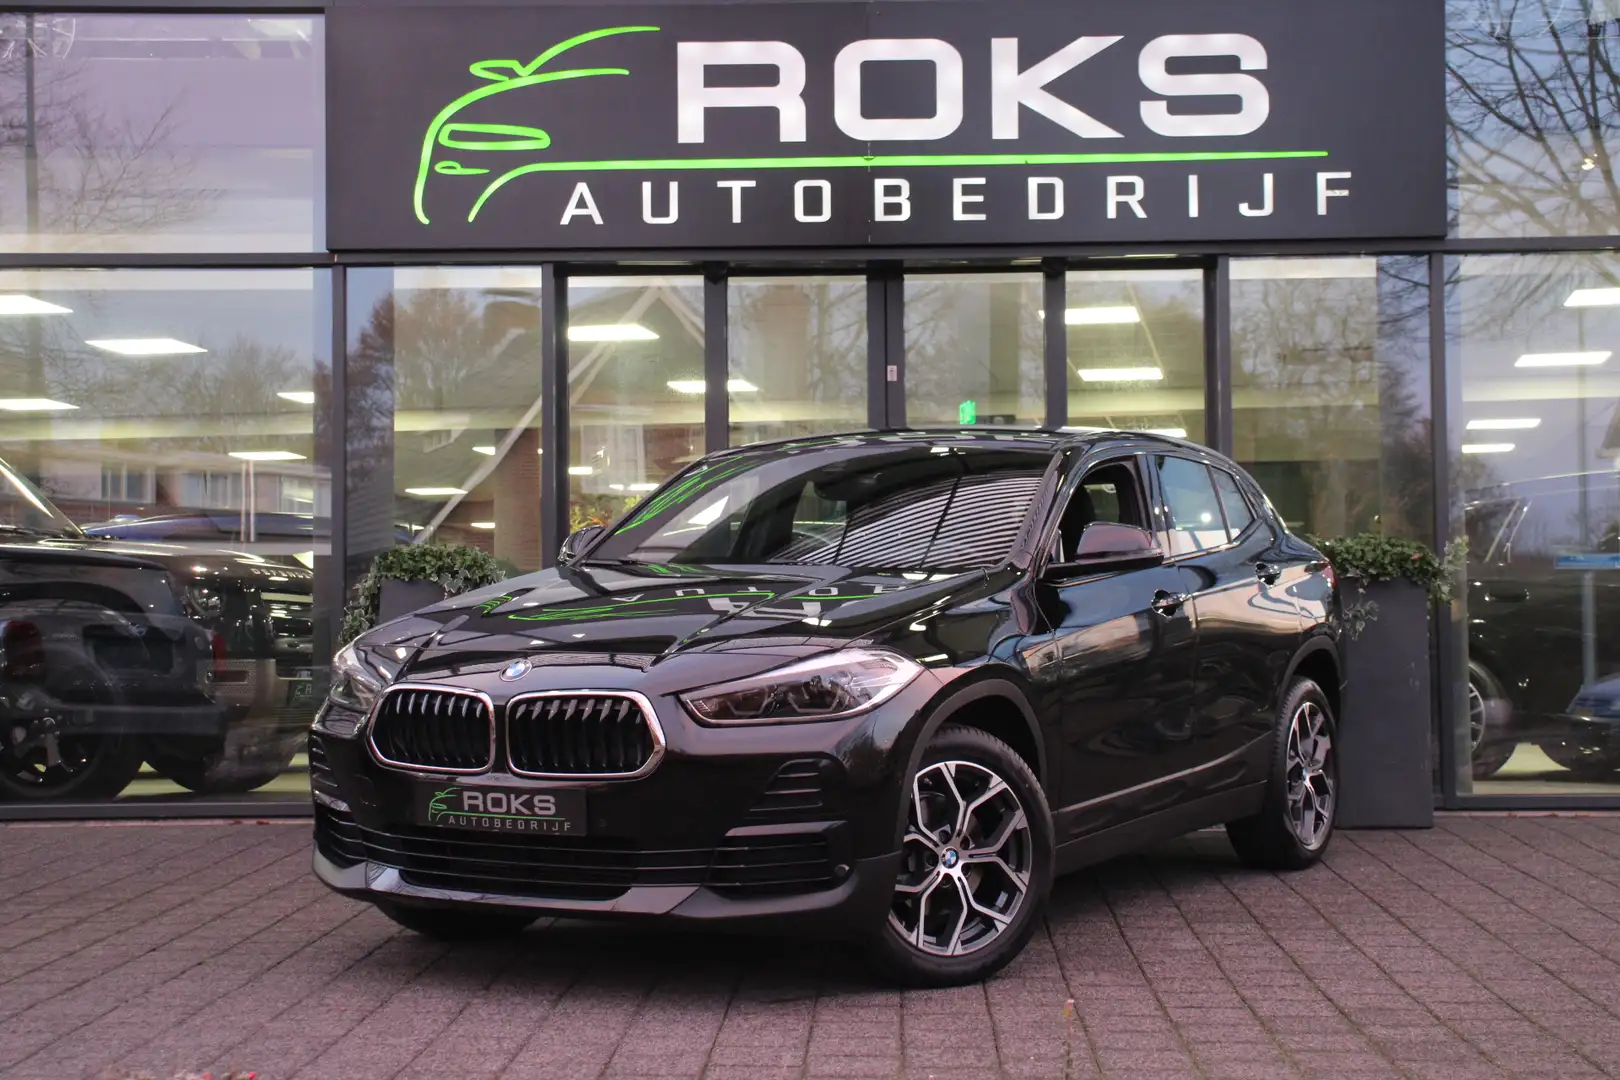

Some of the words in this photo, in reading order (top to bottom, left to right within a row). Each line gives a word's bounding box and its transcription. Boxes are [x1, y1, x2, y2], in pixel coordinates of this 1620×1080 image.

[676, 33, 1270, 144] ROKS
[559, 171, 1352, 226] AUTOBEDRIJF
[462, 790, 556, 816] ROKS
[448, 815, 572, 832] AUTOBEDRIJF
